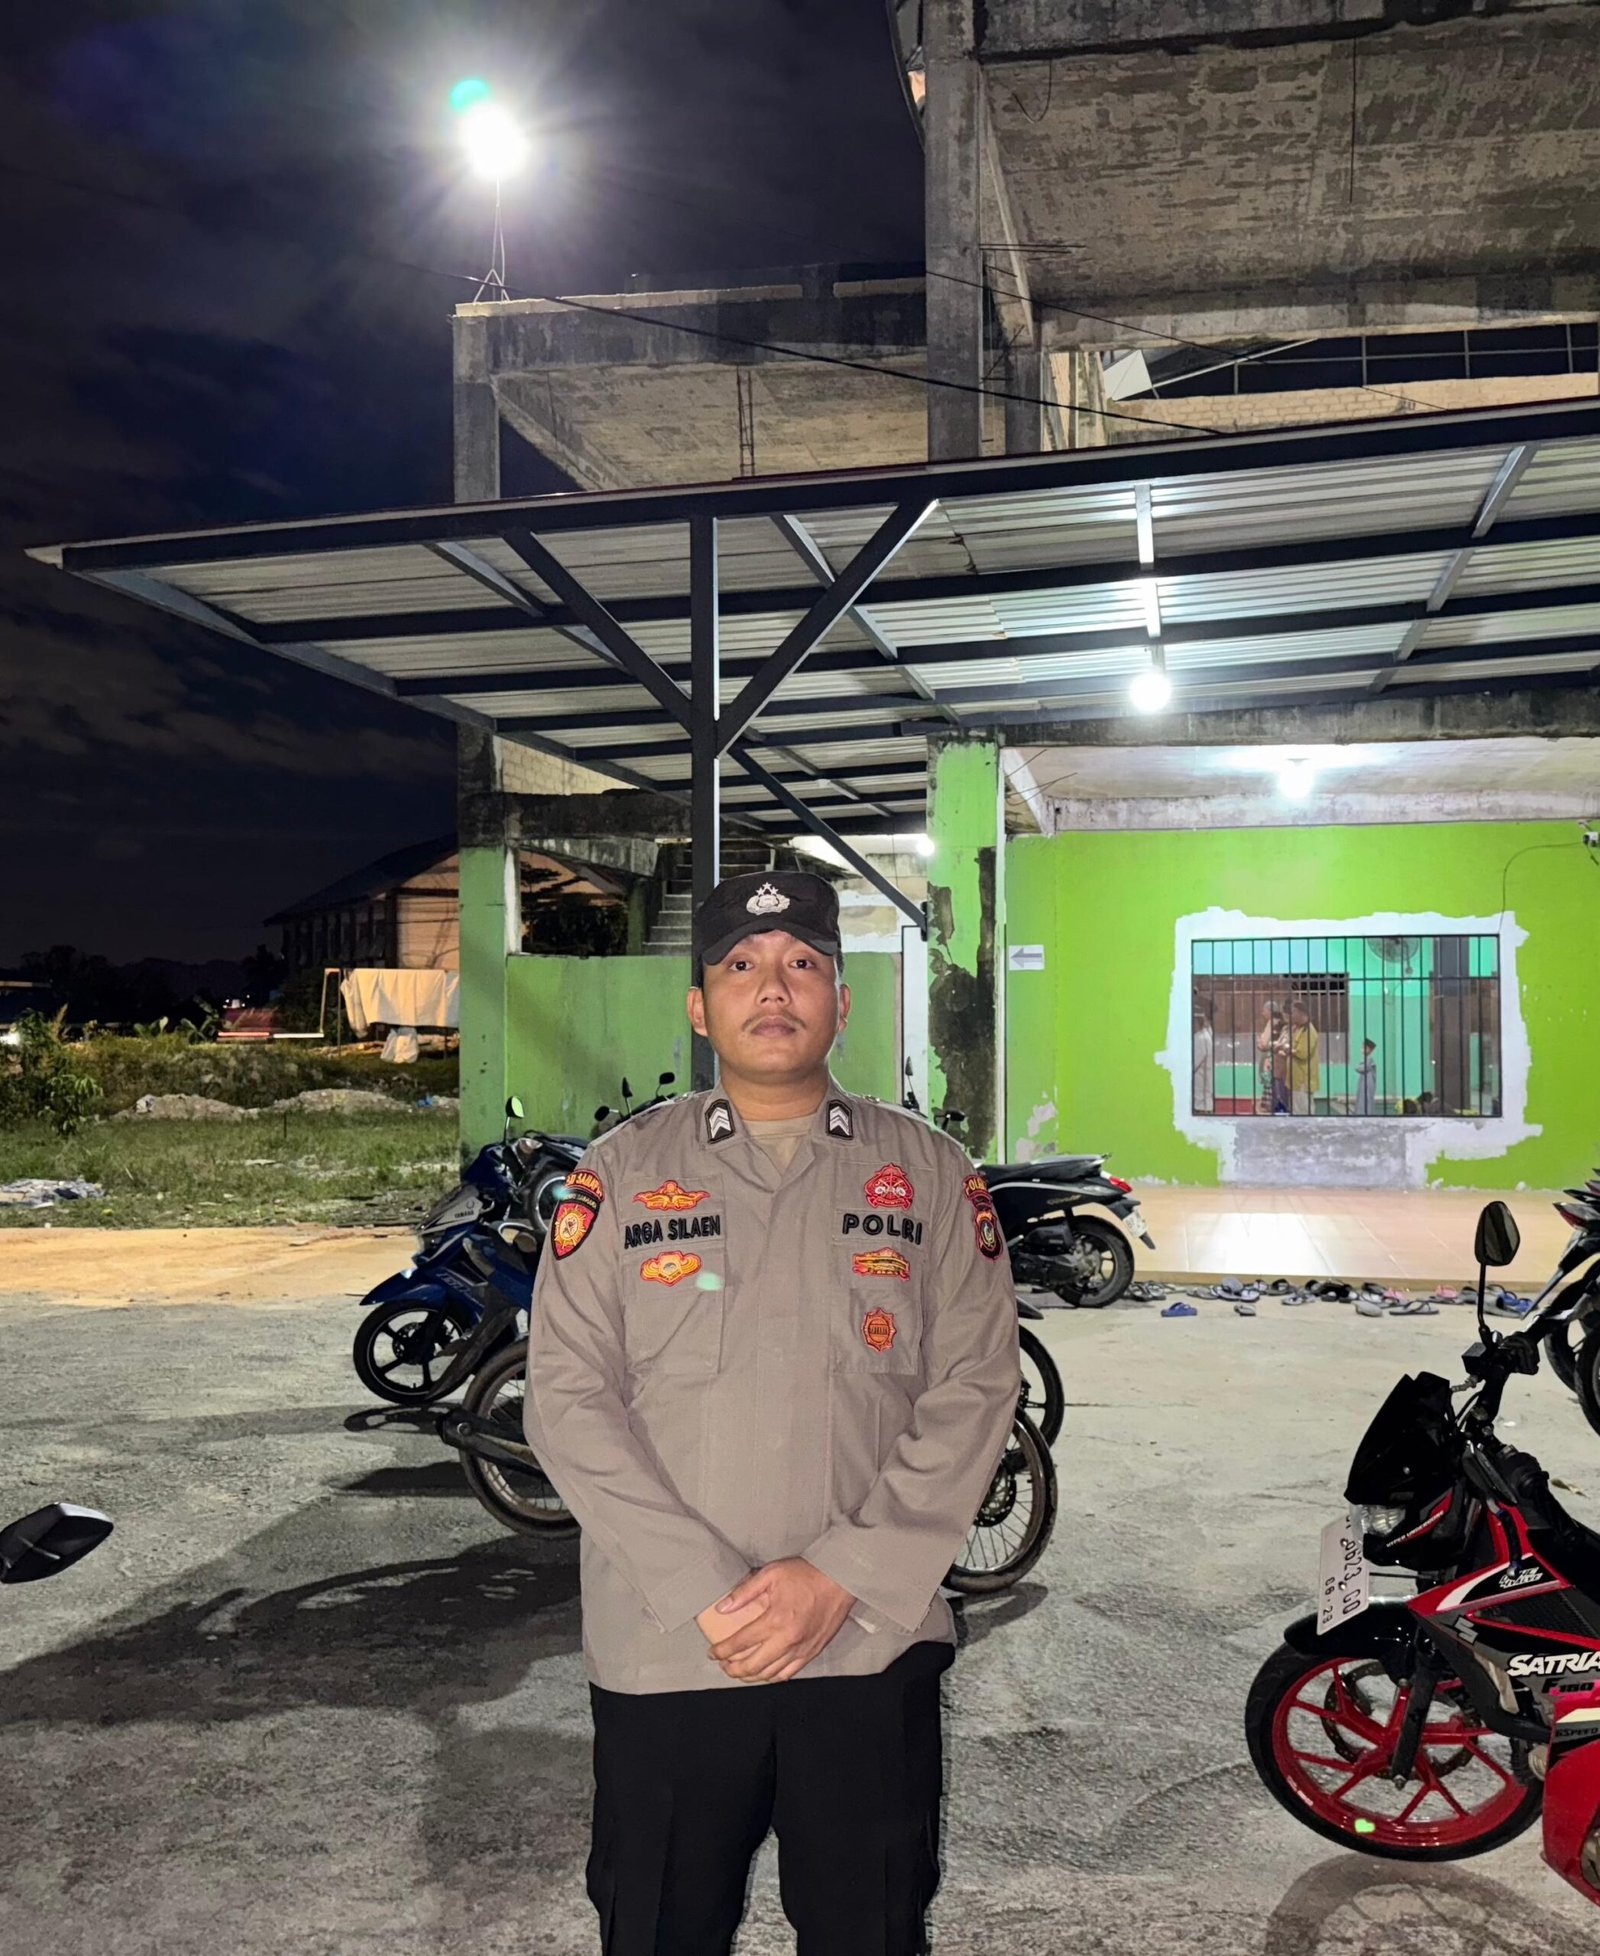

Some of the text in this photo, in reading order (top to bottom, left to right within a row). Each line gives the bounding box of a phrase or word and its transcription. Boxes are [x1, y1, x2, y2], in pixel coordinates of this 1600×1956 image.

[624, 1214, 721, 1249] ARGA SILAEN
[842, 1213, 922, 1245] POLRI
[1506, 1651, 1600, 1677] SATRIA
